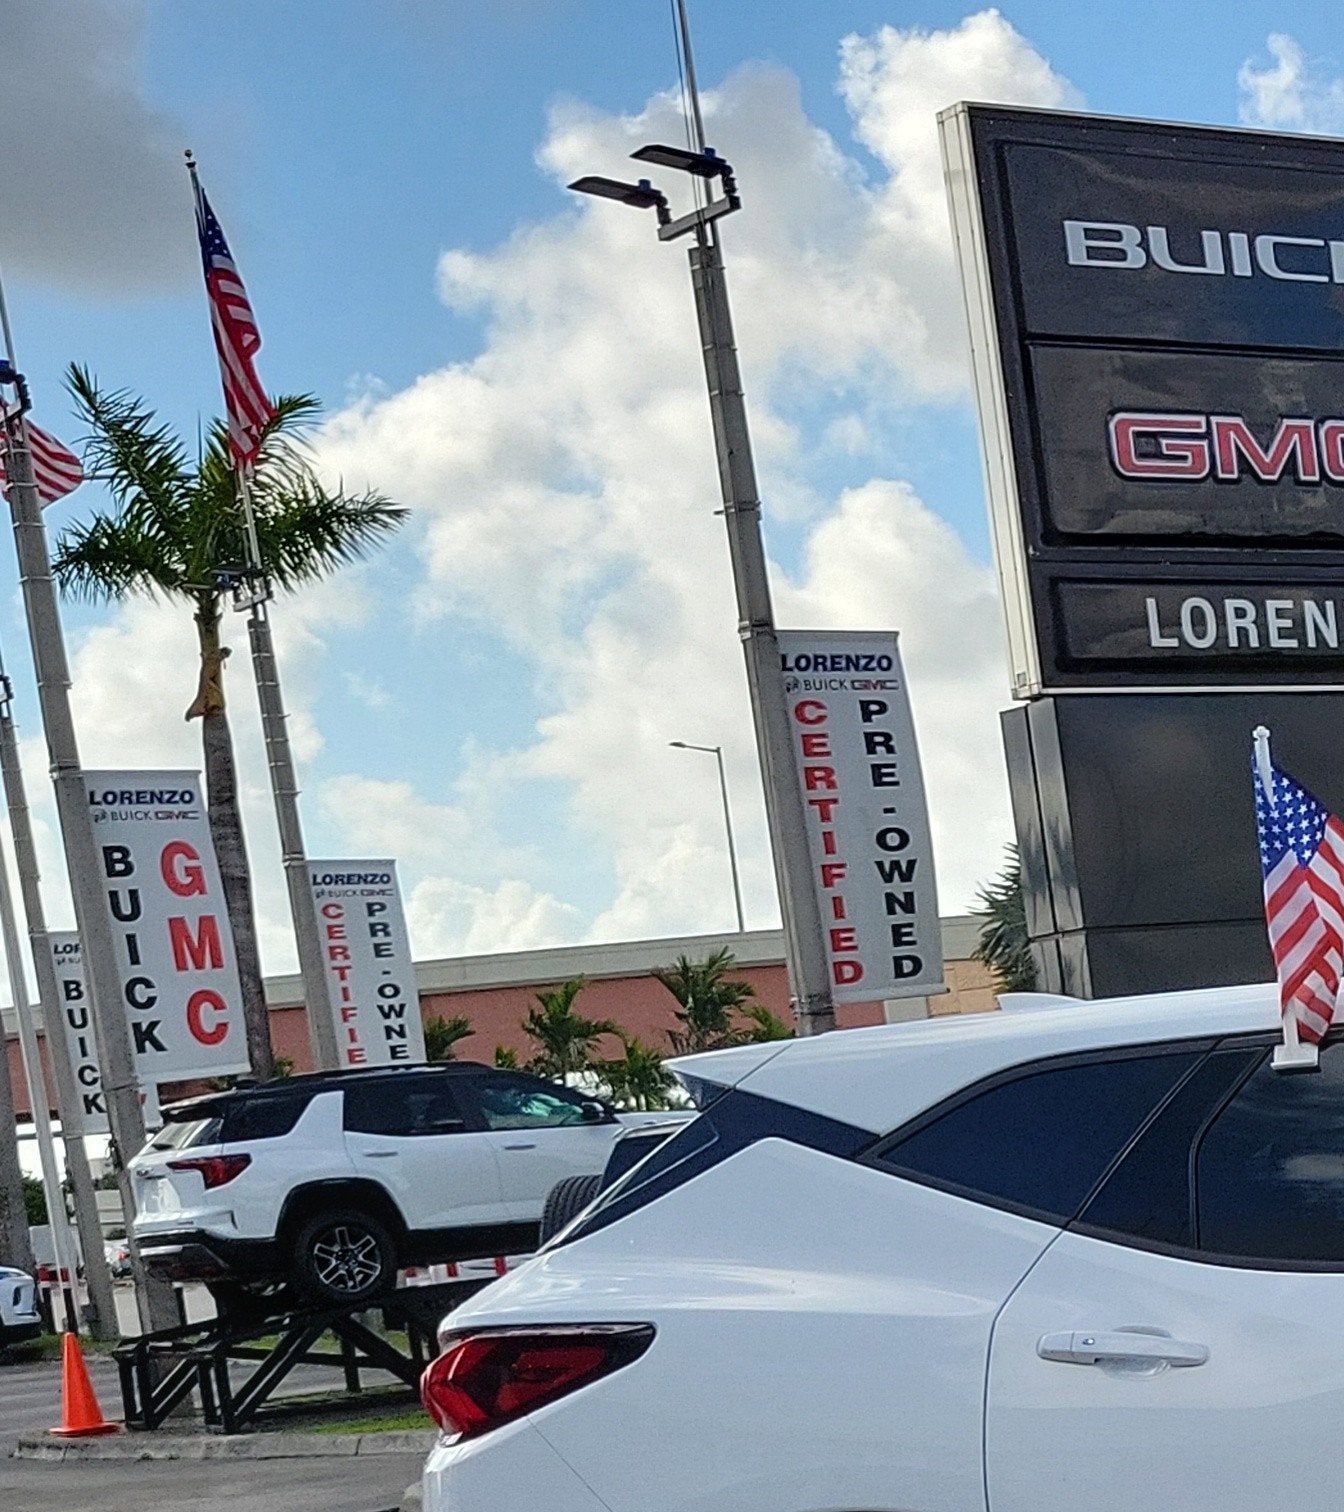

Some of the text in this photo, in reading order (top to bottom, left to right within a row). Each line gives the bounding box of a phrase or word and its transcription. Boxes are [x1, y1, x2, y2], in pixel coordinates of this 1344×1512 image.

[781, 654, 893, 672] LORENZO
[803, 679, 899, 691] BUICK GMC
[89, 790, 195, 805] LORENZO
[110, 811, 199, 821] BUICK GMC
[795, 700, 864, 985] CERTIFIED
[859, 699, 924, 980] PRE-OWNED
[102, 845, 169, 1054] BUICK
[160, 840, 229, 1046] GMC
[312, 873, 391, 886] LORENZO
[63, 979, 107, 1115] BUICK
[321, 903, 368, 1064] CERTIFIE
[366, 902, 410, 1061] PRE-OWNE
